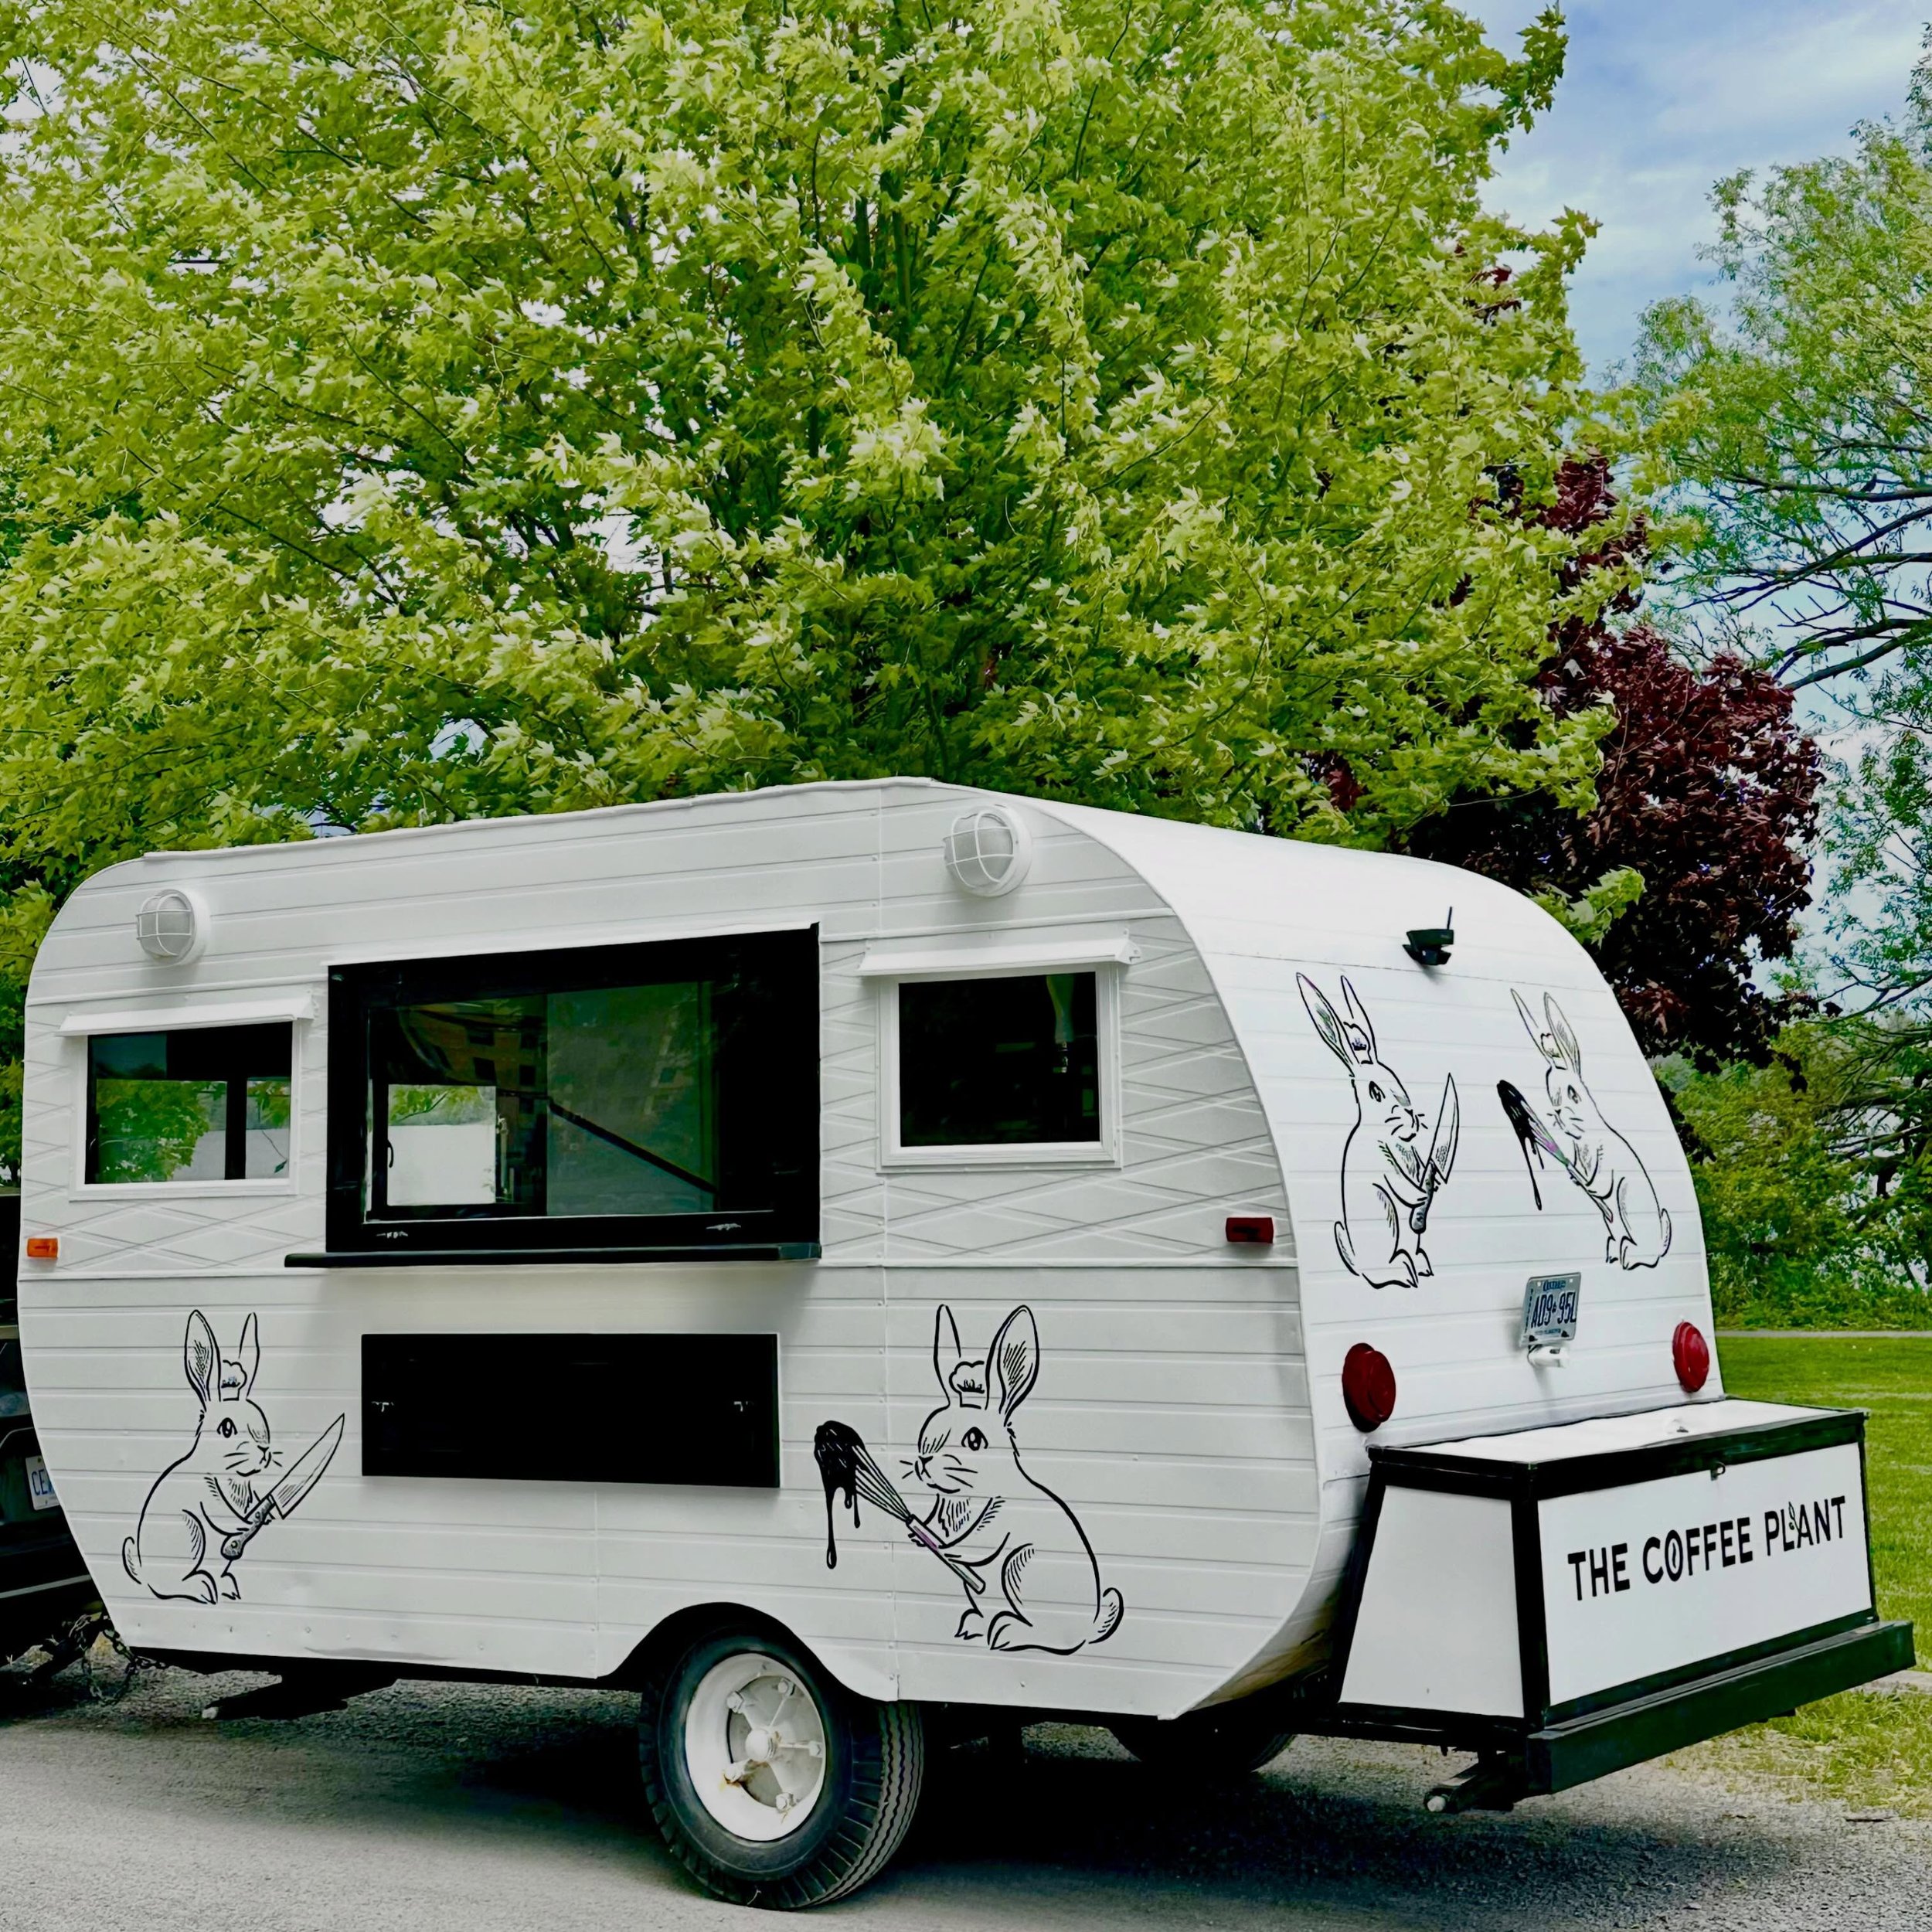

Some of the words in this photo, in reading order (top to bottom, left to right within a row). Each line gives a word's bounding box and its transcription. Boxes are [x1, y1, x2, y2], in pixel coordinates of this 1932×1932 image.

[1567, 1543, 1631, 1601] THE
[1642, 1516, 1753, 1584] COFFEE
[1764, 1495, 1846, 1556] PLANT
